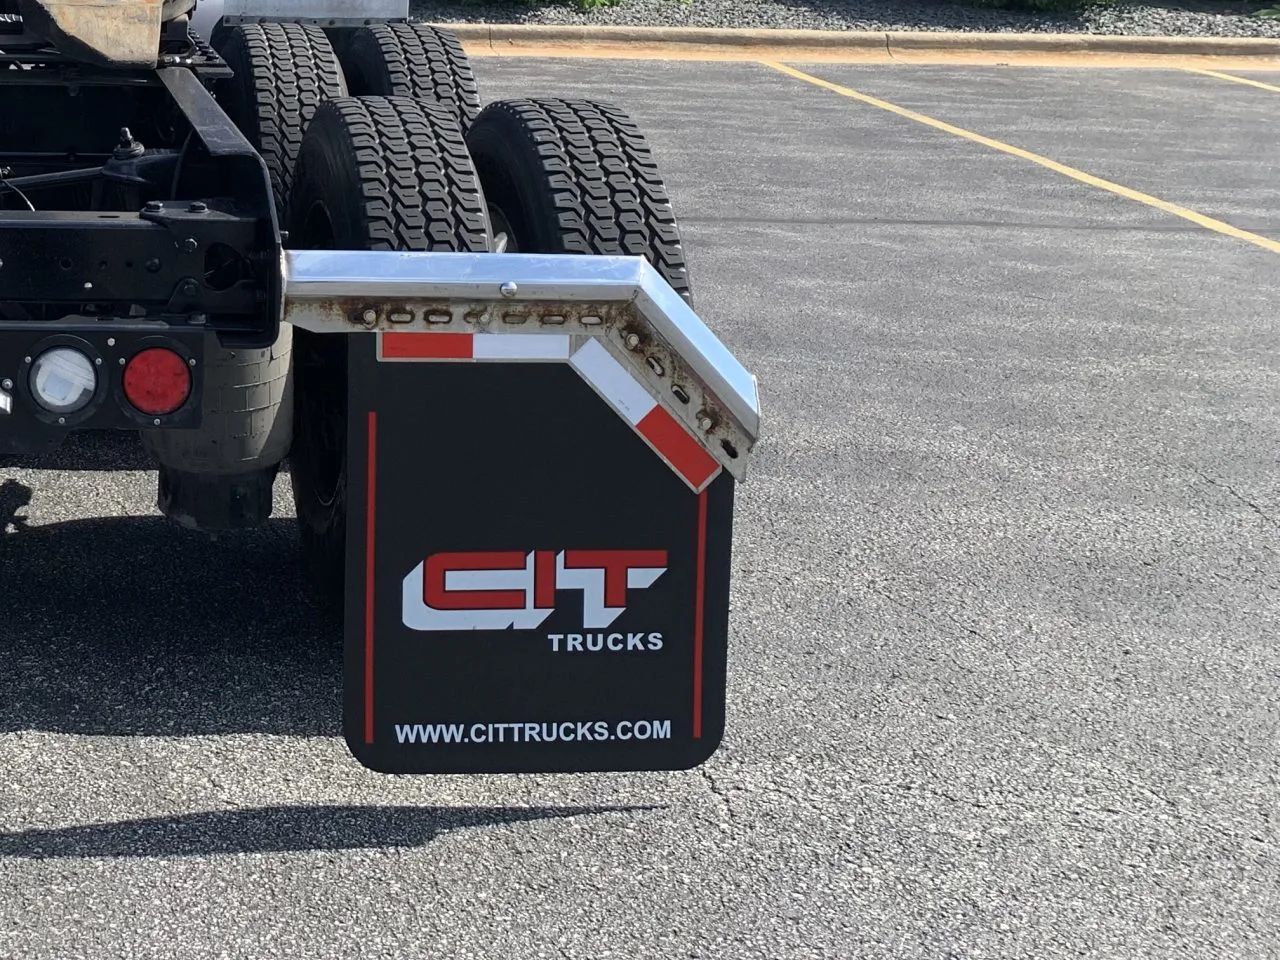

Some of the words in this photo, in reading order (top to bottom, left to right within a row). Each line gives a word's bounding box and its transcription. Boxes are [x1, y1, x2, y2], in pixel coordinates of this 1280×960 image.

[402, 549, 668, 631] CIT
[547, 632, 664, 652] TRUCKS
[394, 720, 671, 744] WWW.CITTRUCKS.COM
